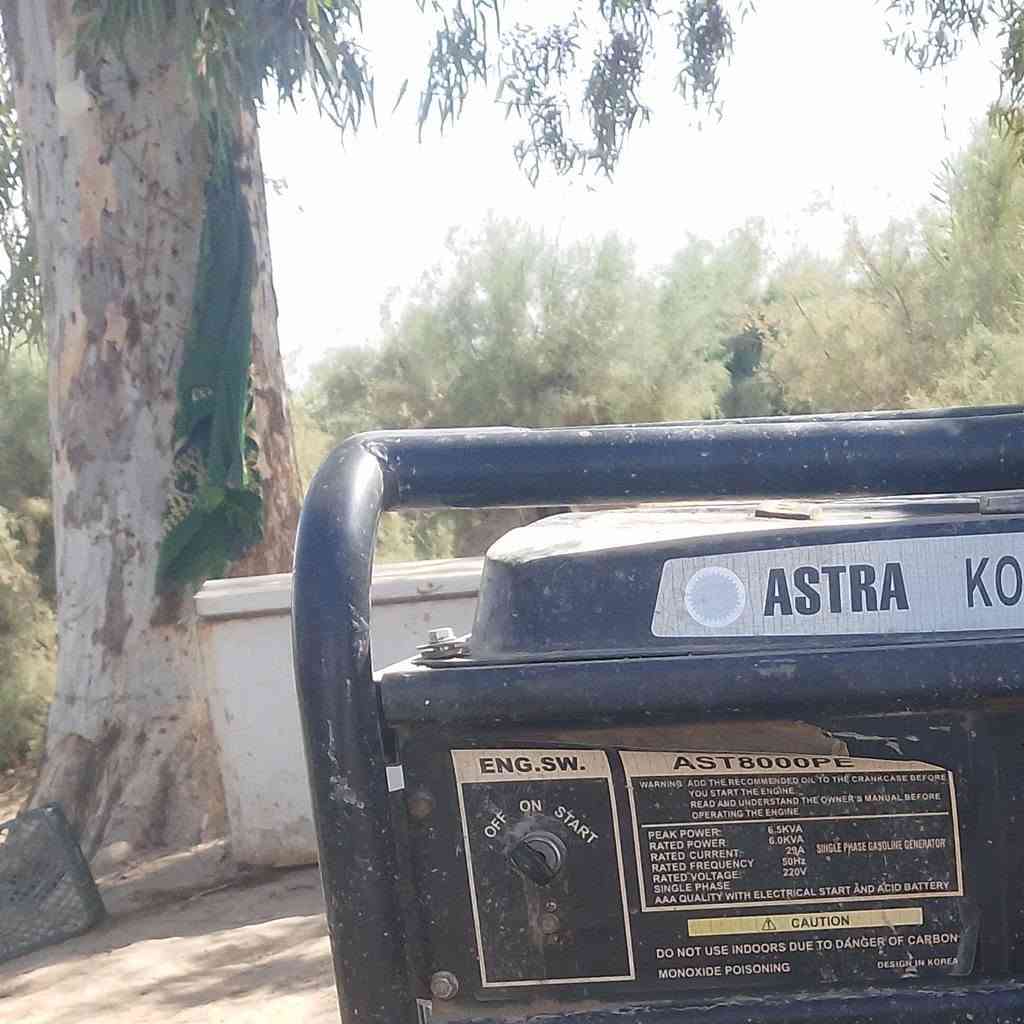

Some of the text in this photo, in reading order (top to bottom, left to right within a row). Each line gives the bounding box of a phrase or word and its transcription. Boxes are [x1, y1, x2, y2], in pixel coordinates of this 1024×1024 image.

[763, 561, 910, 617] ASTRA
[480, 756, 586, 774] ENG.SW.
[673, 756, 855, 770] AST8000PE
[709, 779, 727, 787] THE
[728, 777, 799, 786] RECOMMENDED
[800, 775, 816, 784] OIL
[818, 775, 830, 783] TO
[831, 774, 849, 783] THE
[851, 774, 908, 783] CRANKCASE
[910, 773, 946, 782] BEFORE
[689, 789, 708, 798] YOU
[710, 788, 740, 797] START
[741, 788, 759, 796] THE
[519, 799, 543, 812] ON
[690, 792, 942, 809] READ AND UNDERSTAND THE OWNER'S MANUAL BEFORE
[691, 809, 744, 820] OPERATING
[745, 809, 763, 817] THE
[484, 810, 507, 838] OFF
[554, 806, 599, 844] START
[648, 829, 678, 840] PEAK
[768, 835, 805, 845] 6.0KVA
[649, 840, 685, 851] RATED
[816, 838, 946, 854] SINGLE PHASE GASOLINE GENERATOR
[650, 851, 686, 862] RATED
[782, 857, 807, 867] 50Hz
[651, 859, 755, 873] RATED FREQUENCY
[783, 867, 808, 877] 220V
[652, 873, 688, 883] RATED
[653, 880, 731, 894] SINGLE PHASE
[655, 881, 951, 905] AAA QUALITY WITH ELECTRICAL START AND ACID BATTERY
[791, 916, 850, 929] CAUTION
[656, 932, 959, 959] DO NOT USE INDOORS DUE TO DANGER OF CARBON
[877, 959, 913, 969] DESIGN
[927, 957, 959, 967] KOREA
[658, 962, 791, 979] MONOXIDE POISONING
